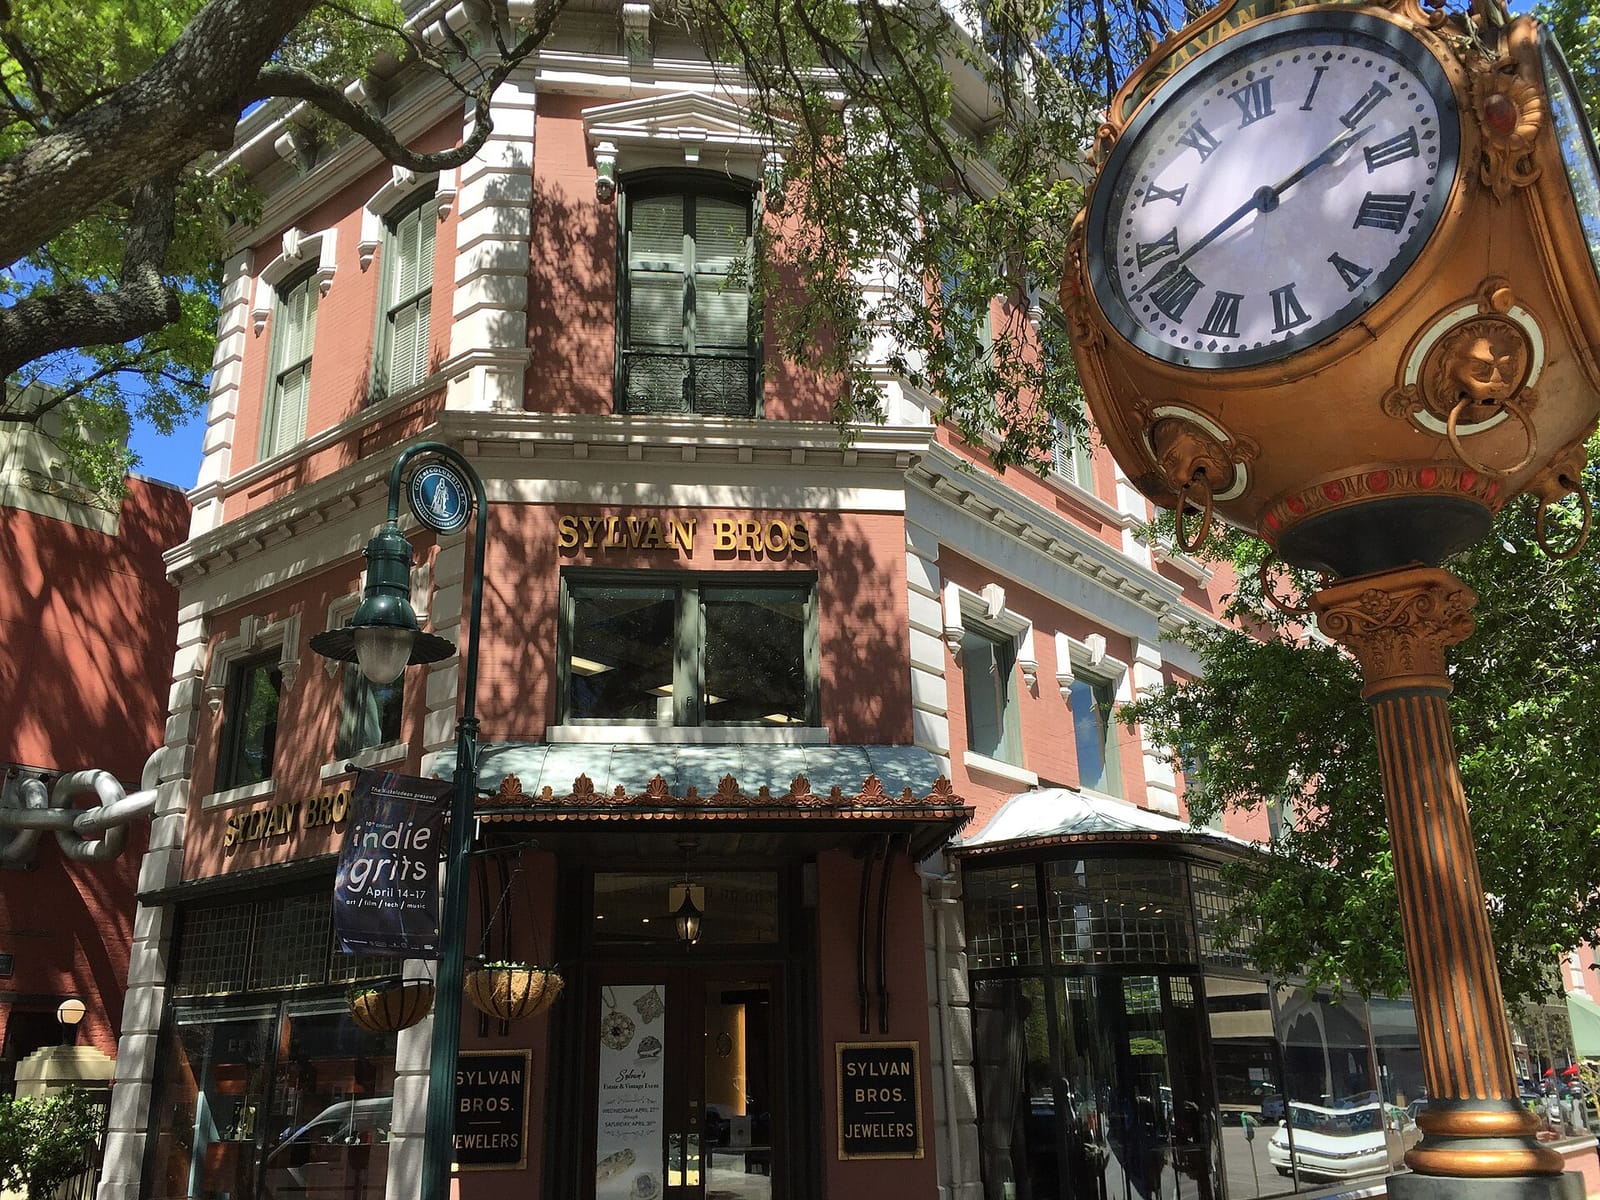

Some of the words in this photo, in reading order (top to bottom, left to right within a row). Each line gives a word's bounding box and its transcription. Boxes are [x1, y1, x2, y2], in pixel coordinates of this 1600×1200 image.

[1228, 75, 1276, 130] XII
[1339, 80, 1392, 129] II
[1176, 118, 1222, 164] XI
[1363, 126, 1420, 173] III
[1142, 182, 1188, 207] X
[1136, 227, 1180, 272] IX
[1327, 252, 1373, 292] V
[1197, 290, 1244, 338] VII
[1269, 282, 1312, 335] VI
[429, 467, 461, 489] COLUMBIA
[558, 515, 697, 549] SYLVAN
[224, 802, 299, 847] SYLVAN
[353, 822, 431, 850] indie
[347, 853, 428, 893] grits
[366, 886, 394, 899] April
[397, 889, 426, 900] 14-17
[385, 900, 399, 908] tech
[406, 902, 426, 910] music
[456, 1070, 521, 1086] SYLVAN
[847, 1062, 911, 1077] SYLVAN
[460, 1098, 515, 1113] BROS.
[855, 1088, 907, 1102] BROS.
[845, 1123, 914, 1138] JEWELERS
